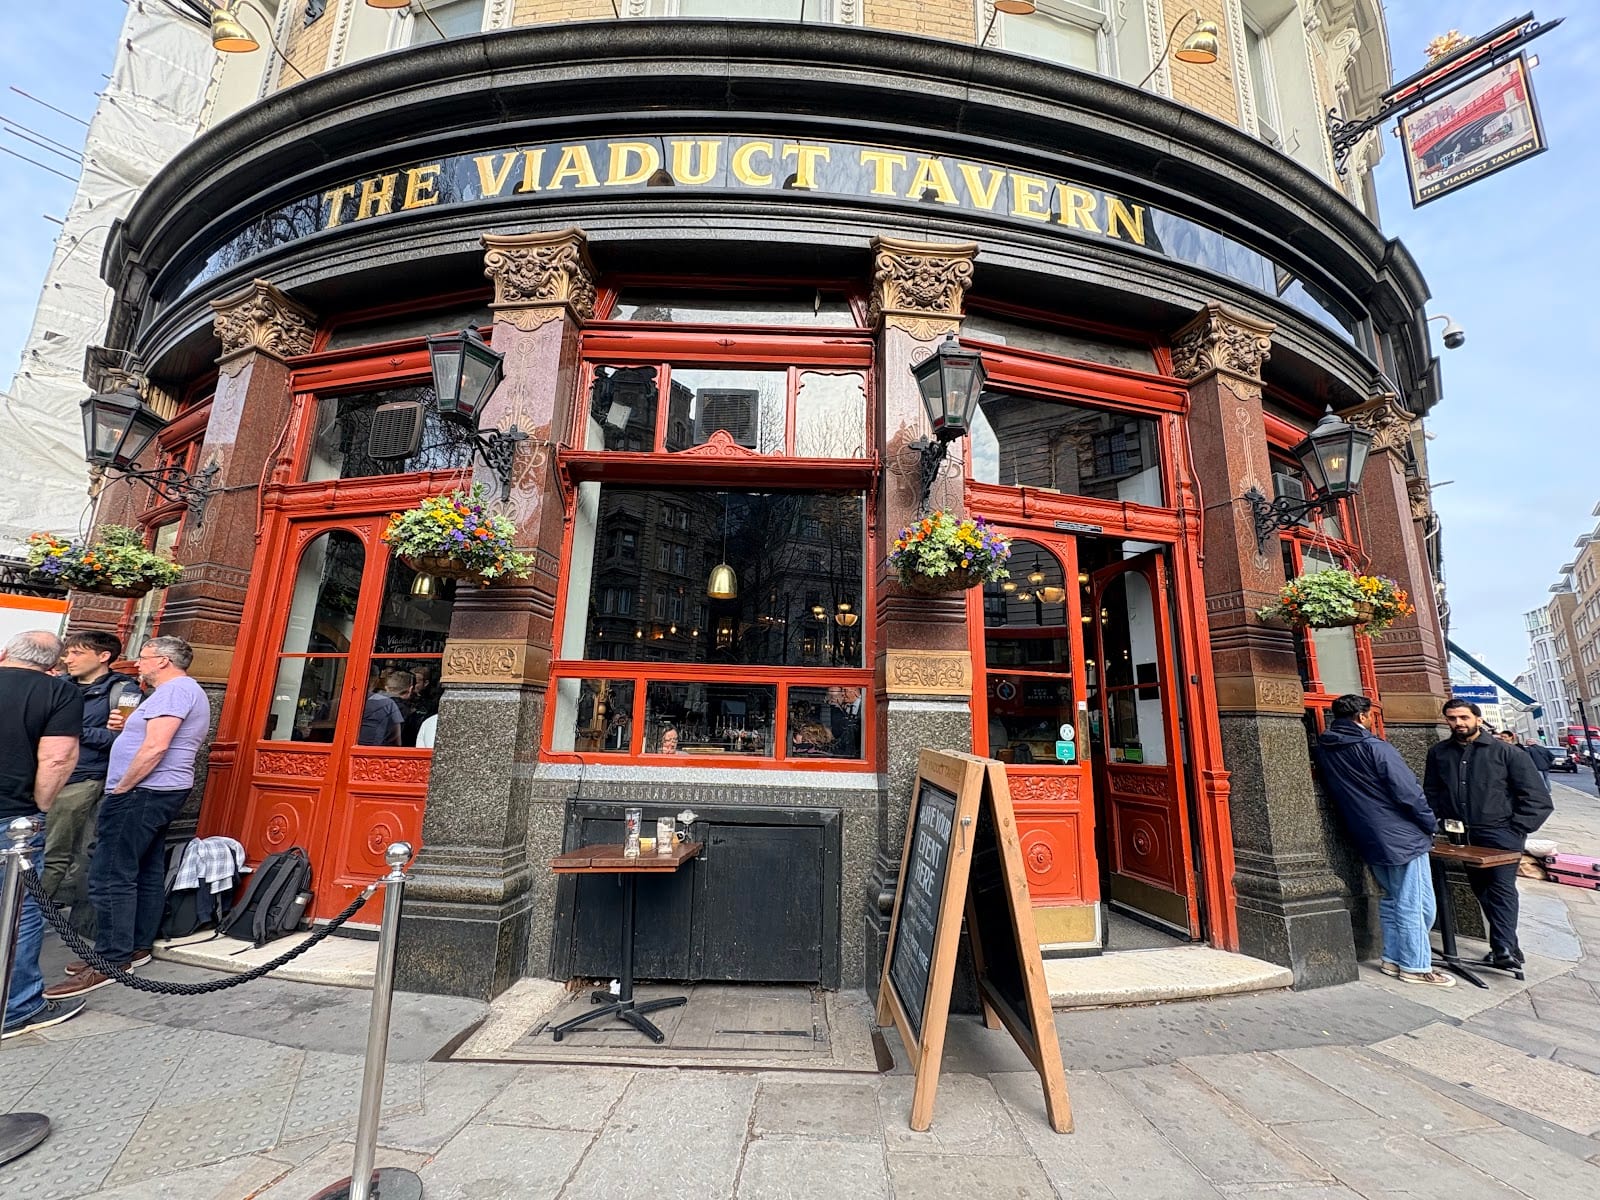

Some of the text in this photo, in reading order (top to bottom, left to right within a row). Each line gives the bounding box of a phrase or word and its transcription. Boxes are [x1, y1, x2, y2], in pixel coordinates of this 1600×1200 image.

[1422, 142, 1532, 196] THE VIADUCT TAVERN
[321, 141, 1146, 246] THE VIADUCT TAVERN
[920, 805, 951, 844] HAVE YOUR
[918, 830, 942, 869] EVENT
[915, 857, 935, 897] HERE
